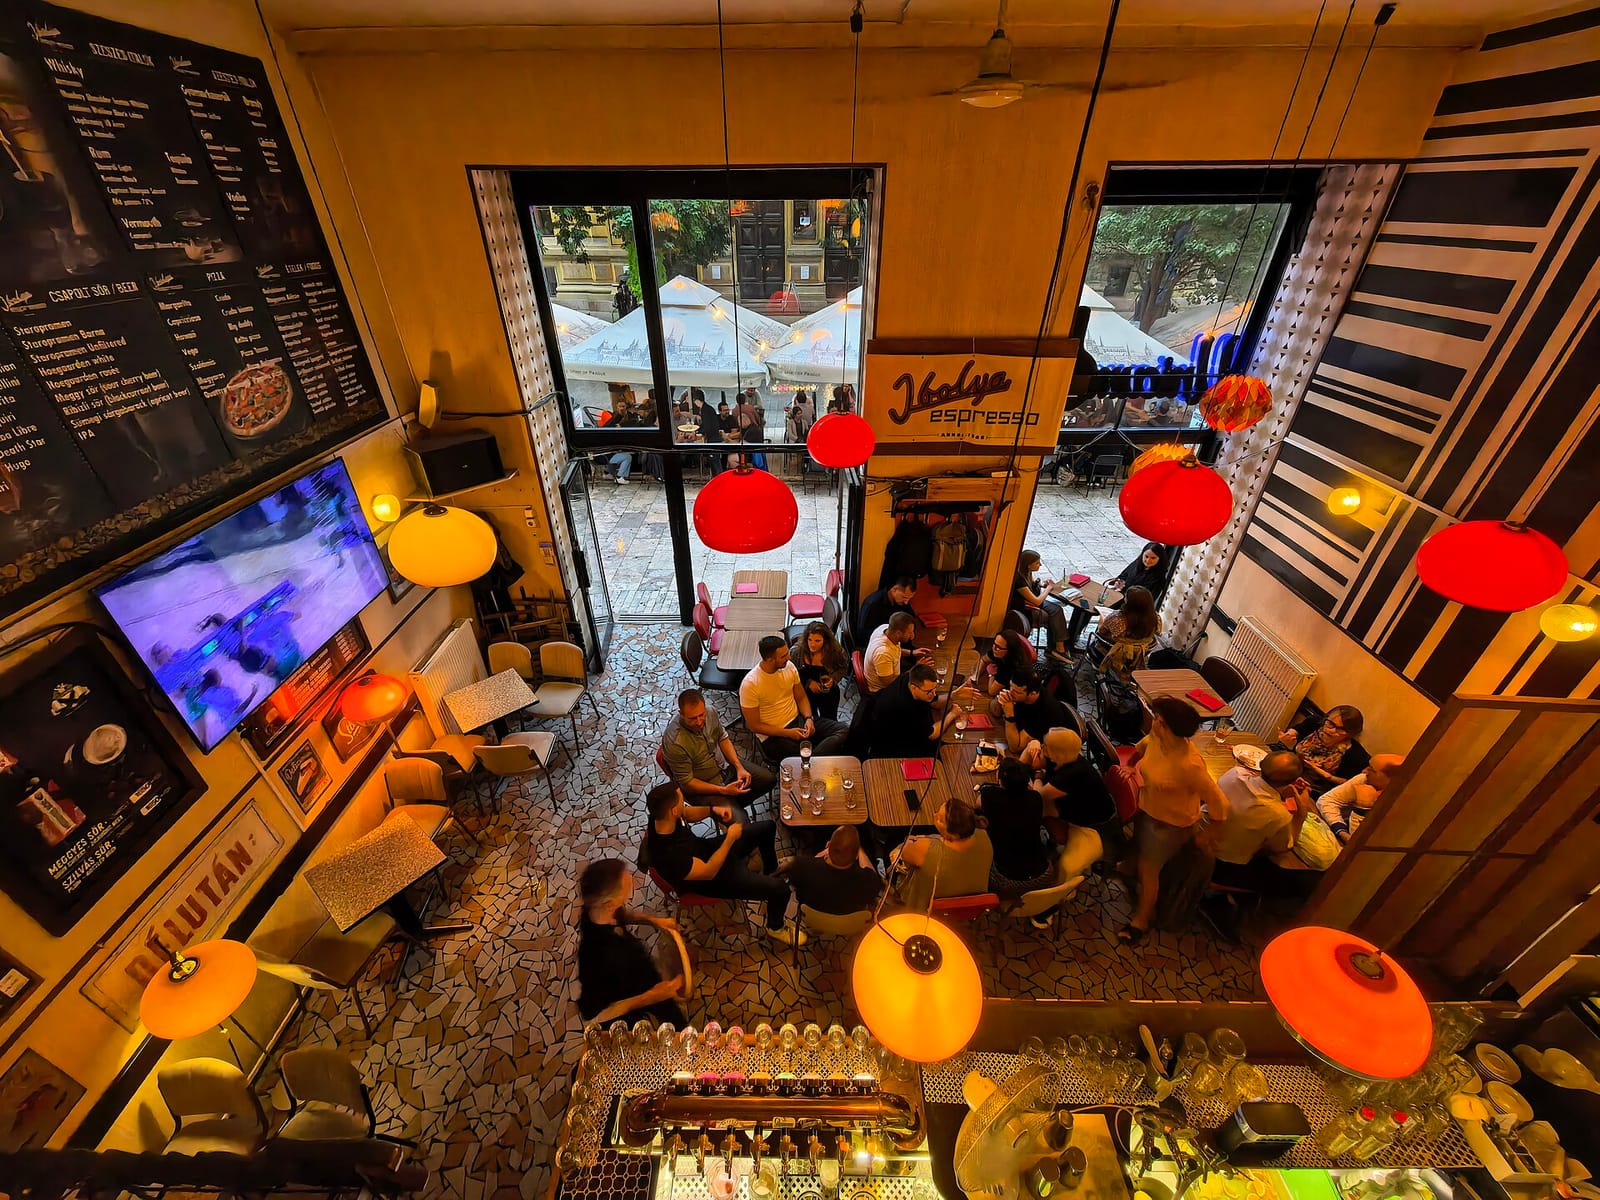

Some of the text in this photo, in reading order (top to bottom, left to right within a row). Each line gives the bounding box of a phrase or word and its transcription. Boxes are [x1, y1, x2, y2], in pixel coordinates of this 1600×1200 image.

[44, 57, 84, 78] Whisky
[48, 287, 91, 303] CSAPOLT
[91, 284, 110, 297] SÖR
[14, 320, 72, 336] Staropramen
[22, 333, 80, 350] Staropramen
[30, 346, 88, 364] Staropramen
[930, 409, 1040, 428] espresso
[12, 424, 38, 437] Libre
[78, 429, 96, 441] IPA
[0, 437, 46, 460] Death Star
[4, 458, 31, 472] Hugo
[48, 838, 88, 876] MEGGYES
[62, 857, 95, 890] SZILVÁS
